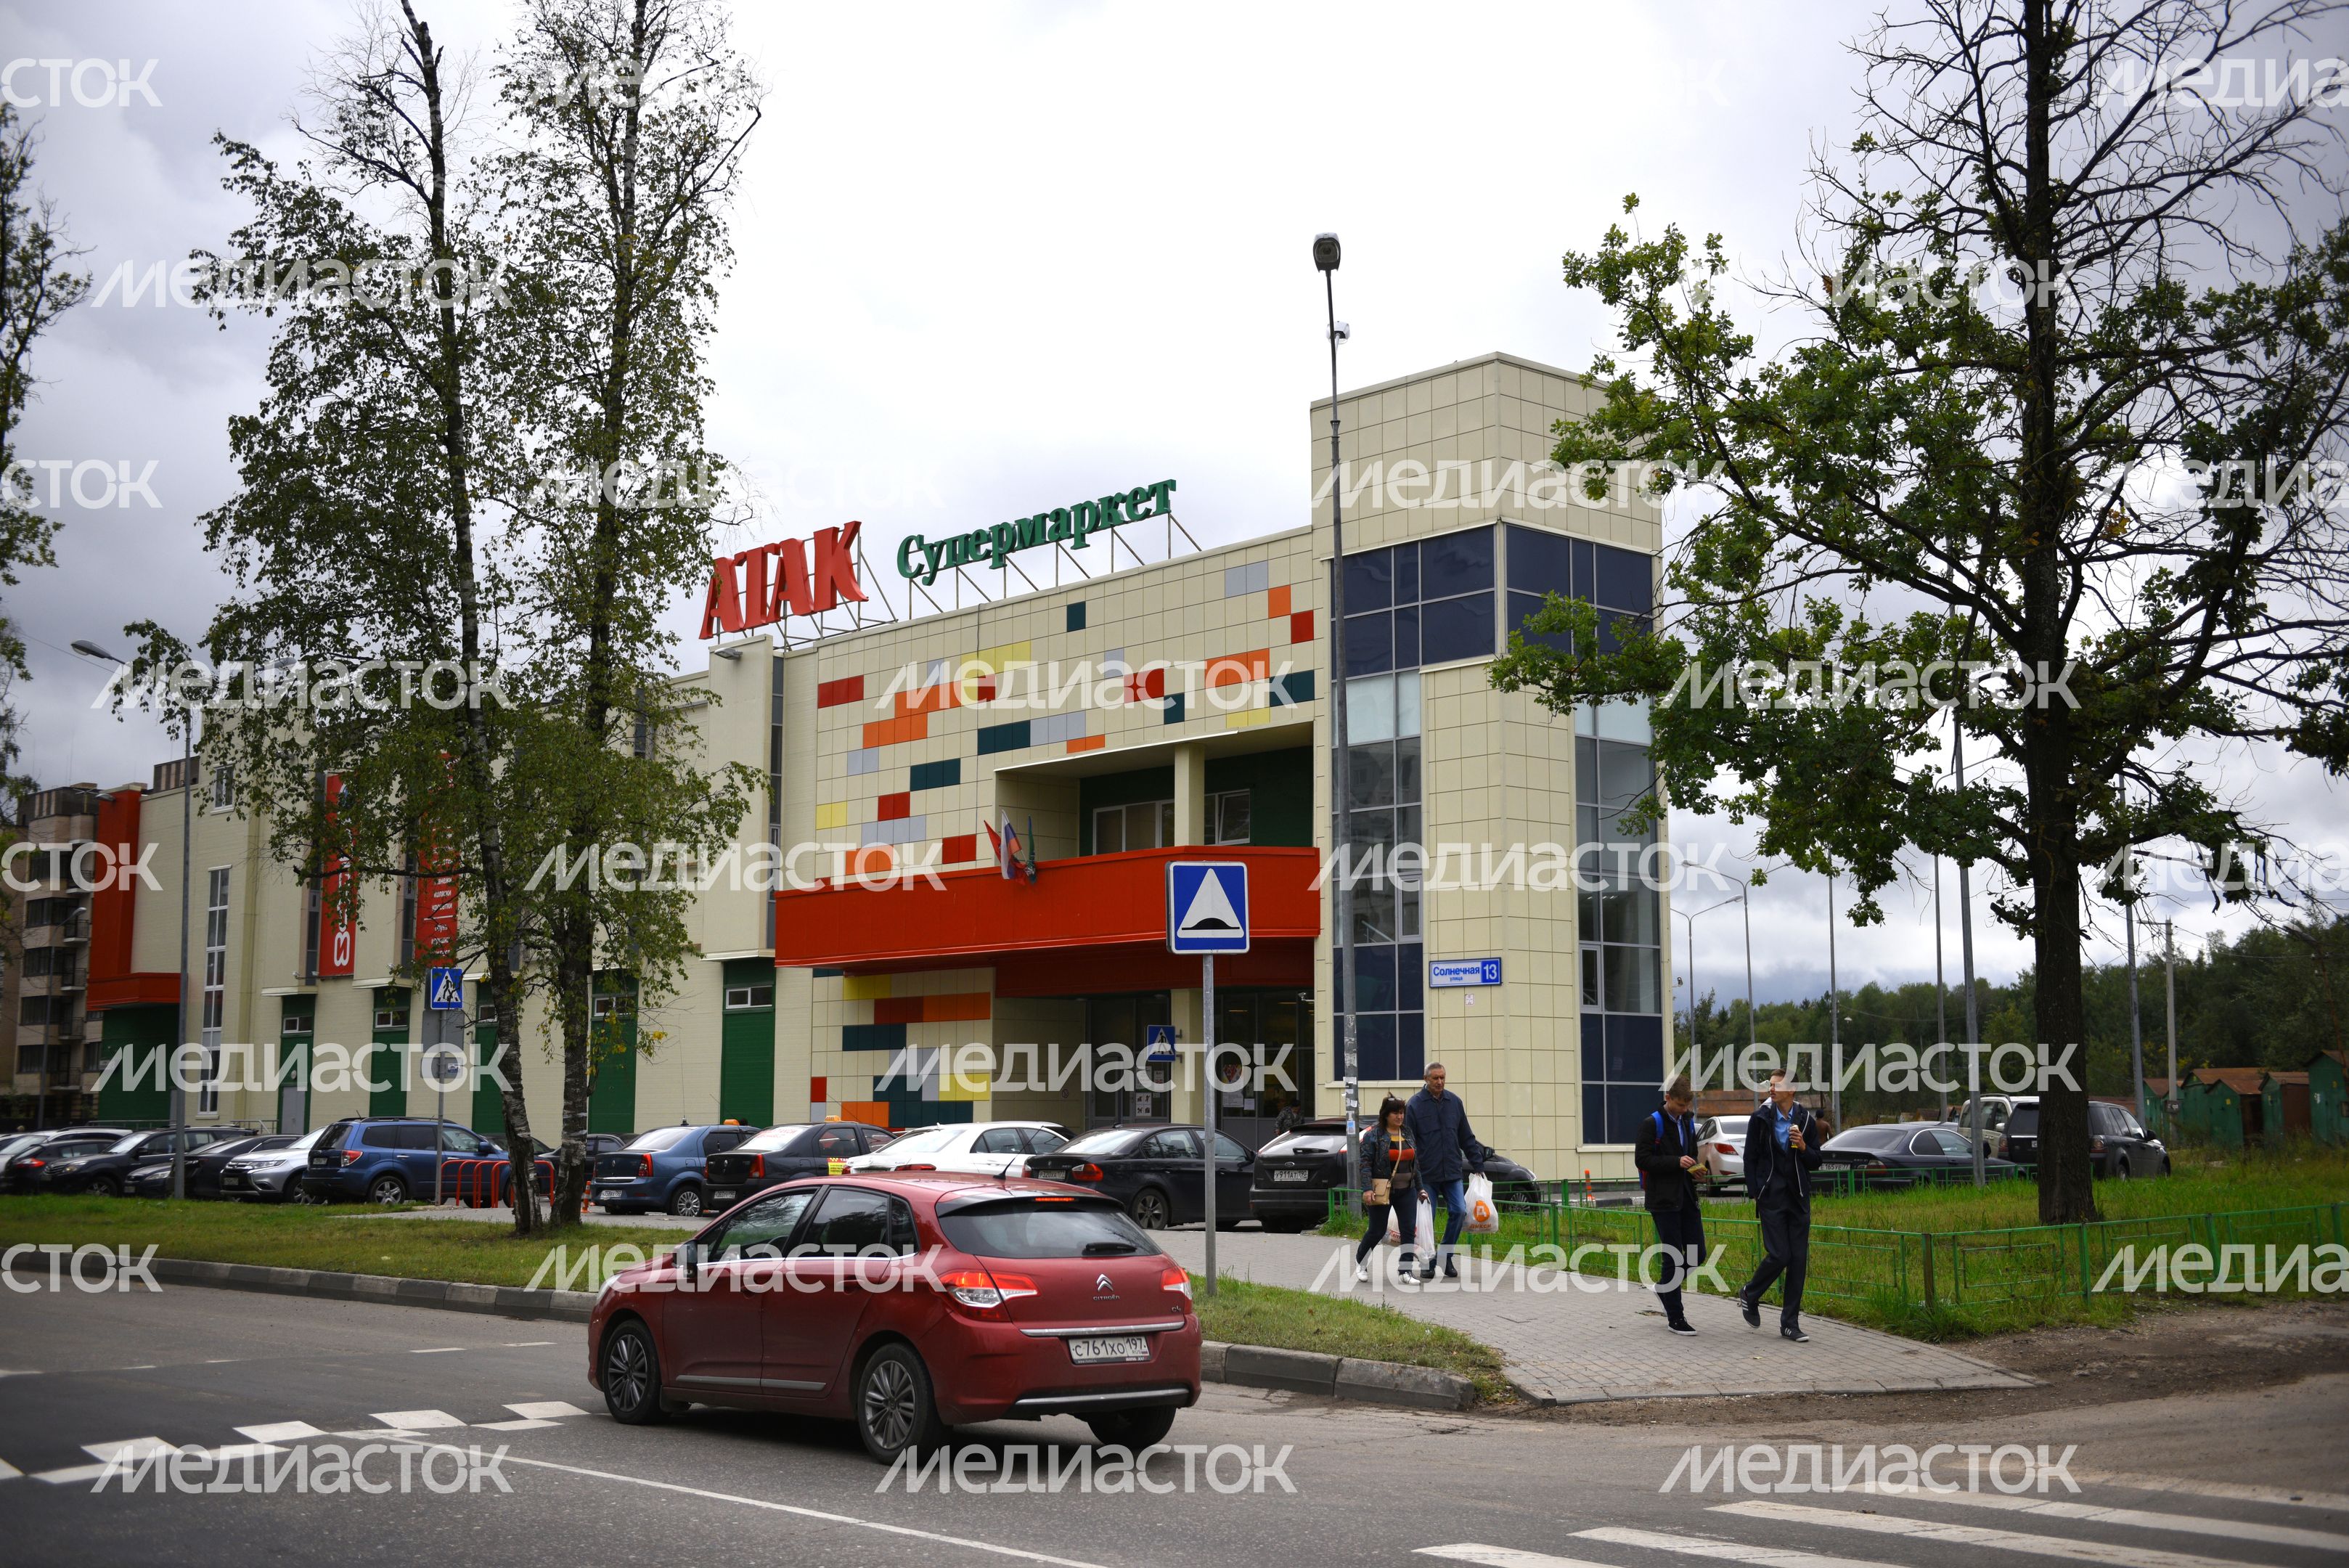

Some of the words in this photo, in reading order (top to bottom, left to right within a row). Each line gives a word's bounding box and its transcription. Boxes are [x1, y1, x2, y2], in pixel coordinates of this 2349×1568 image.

[698, 521, 868, 640] АТАК
[897, 479, 1176, 585] Супермаркет
[1433, 966, 1479, 976] Солнечная
[1484, 963, 1498, 980] 13
